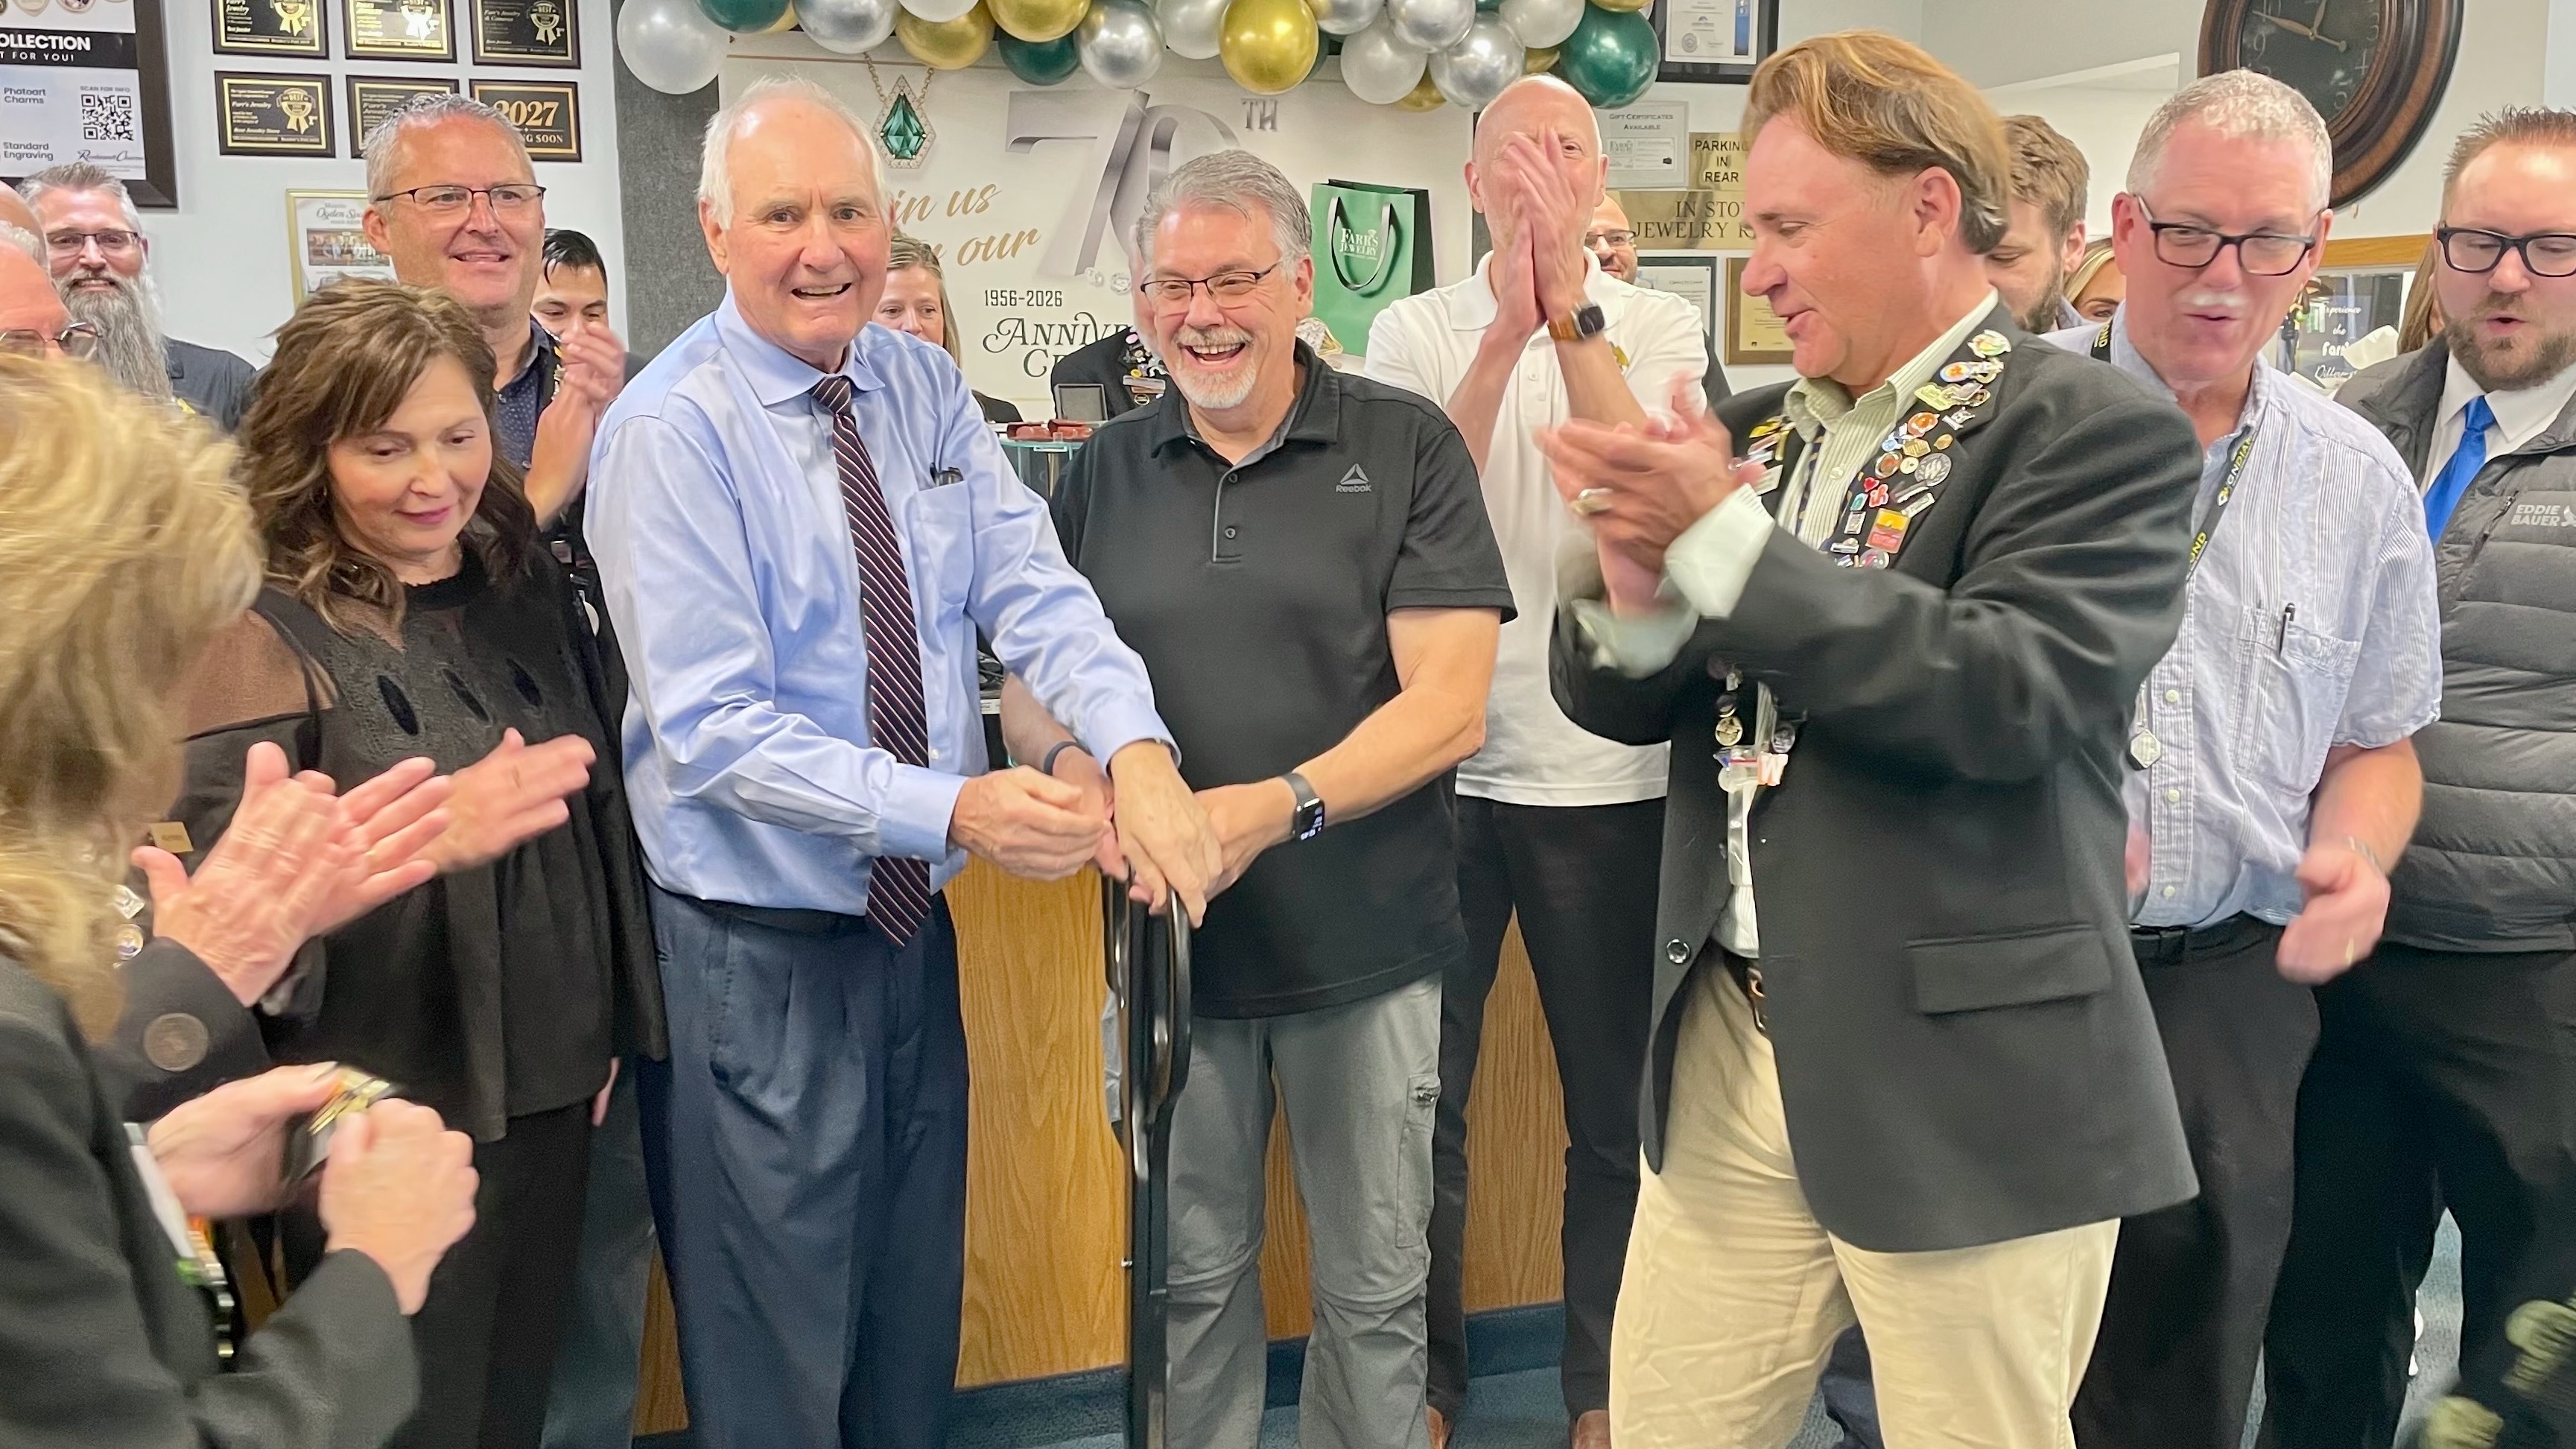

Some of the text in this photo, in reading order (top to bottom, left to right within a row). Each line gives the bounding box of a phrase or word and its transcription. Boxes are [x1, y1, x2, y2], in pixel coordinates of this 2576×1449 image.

[12, 51, 37, 60] FOR
[43, 53, 74, 62] YOU!
[4, 87, 46, 96] Photoart
[4, 96, 44, 104] Charms
[494, 100, 559, 127] 2027
[1241, 98, 1278, 131] TH
[536, 134, 563, 144] SOON
[3, 142, 49, 150] Standard
[4, 150, 54, 161] Engraving
[1716, 156, 1728, 167] IN
[1704, 171, 1739, 183] REAR
[946, 183, 1003, 218] us
[1676, 200, 1696, 218] IN
[1635, 221, 1729, 238] JEWELRY
[957, 228, 1041, 267] our
[1339, 242, 1377, 256] JEWELRY
[984, 289, 1063, 307] 1956-2026
[1336, 484, 1372, 492] Reebok
[2515, 504, 2561, 516] EDDIE
[2510, 514, 2561, 527] BAUER
